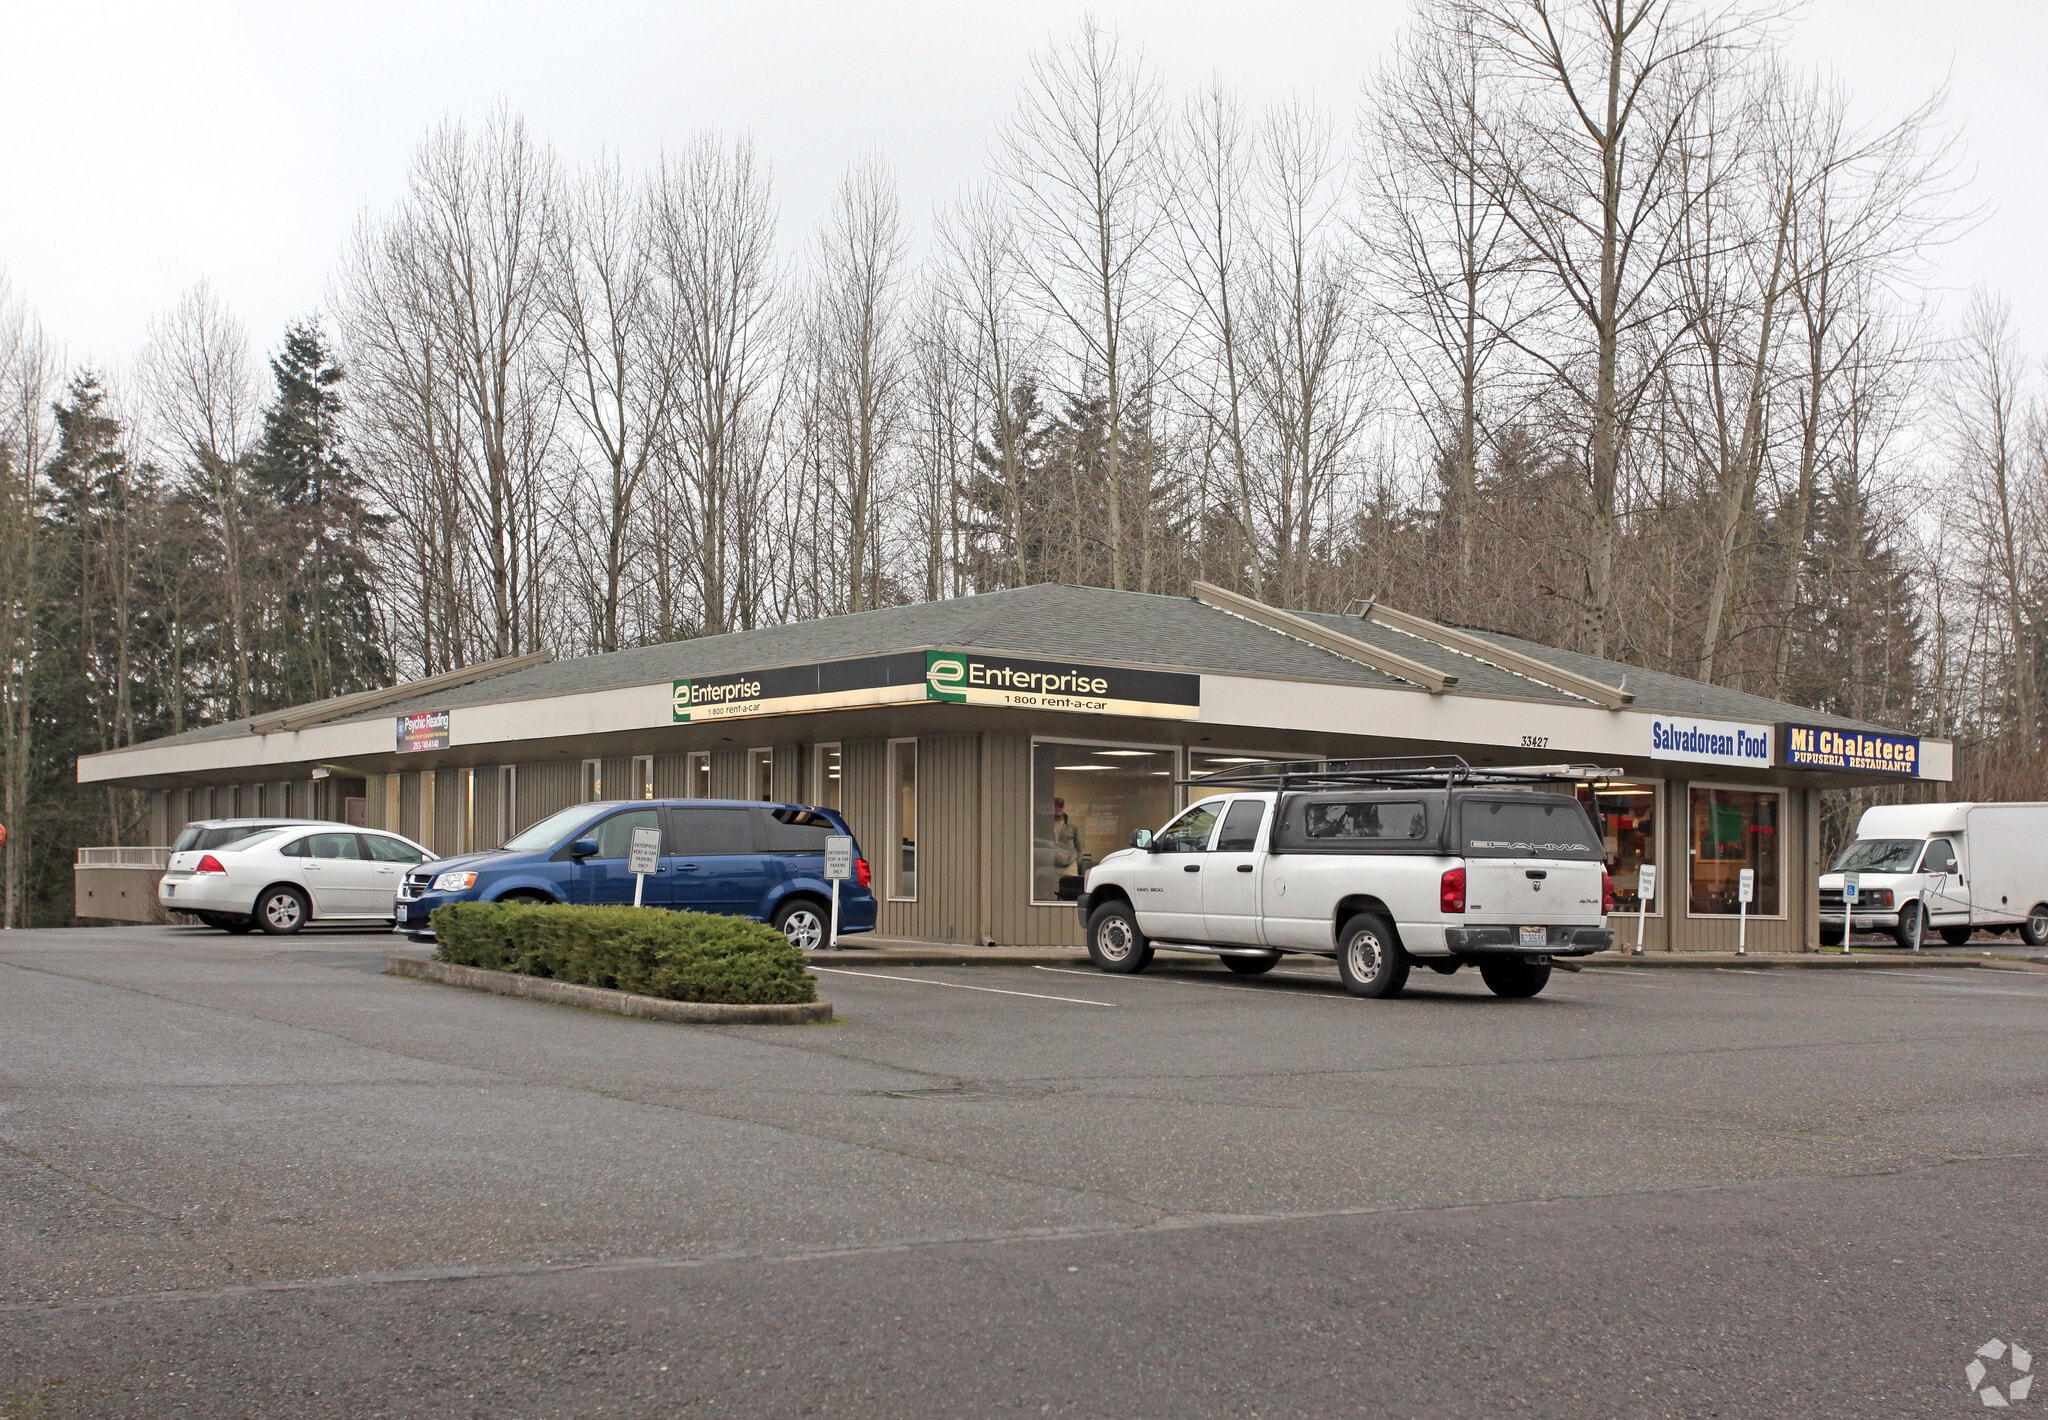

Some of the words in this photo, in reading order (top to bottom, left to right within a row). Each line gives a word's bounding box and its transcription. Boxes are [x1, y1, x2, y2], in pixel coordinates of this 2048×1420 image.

[968, 662, 1108, 694] Enterprise
[690, 677, 761, 704] Enterprise
[712, 707, 724, 715] 800
[725, 703, 761, 714] rent-a-car
[1004, 695, 1010, 703] 1
[1014, 696, 1037, 705] 800
[1041, 696, 1108, 710] rent-a-car
[404, 715, 426, 734] Psychic
[425, 712, 449, 730] Reading
[1520, 735, 1549, 749] 33427
[1652, 721, 1734, 756] Salvadorean
[1737, 729, 1767, 759] Food
[1791, 728, 1815, 752] Mi
[1819, 731, 1916, 762] Chalateca
[1794, 751, 1845, 767] PUPUSERIA
[1849, 756, 1912, 773] RESTAURANTE
